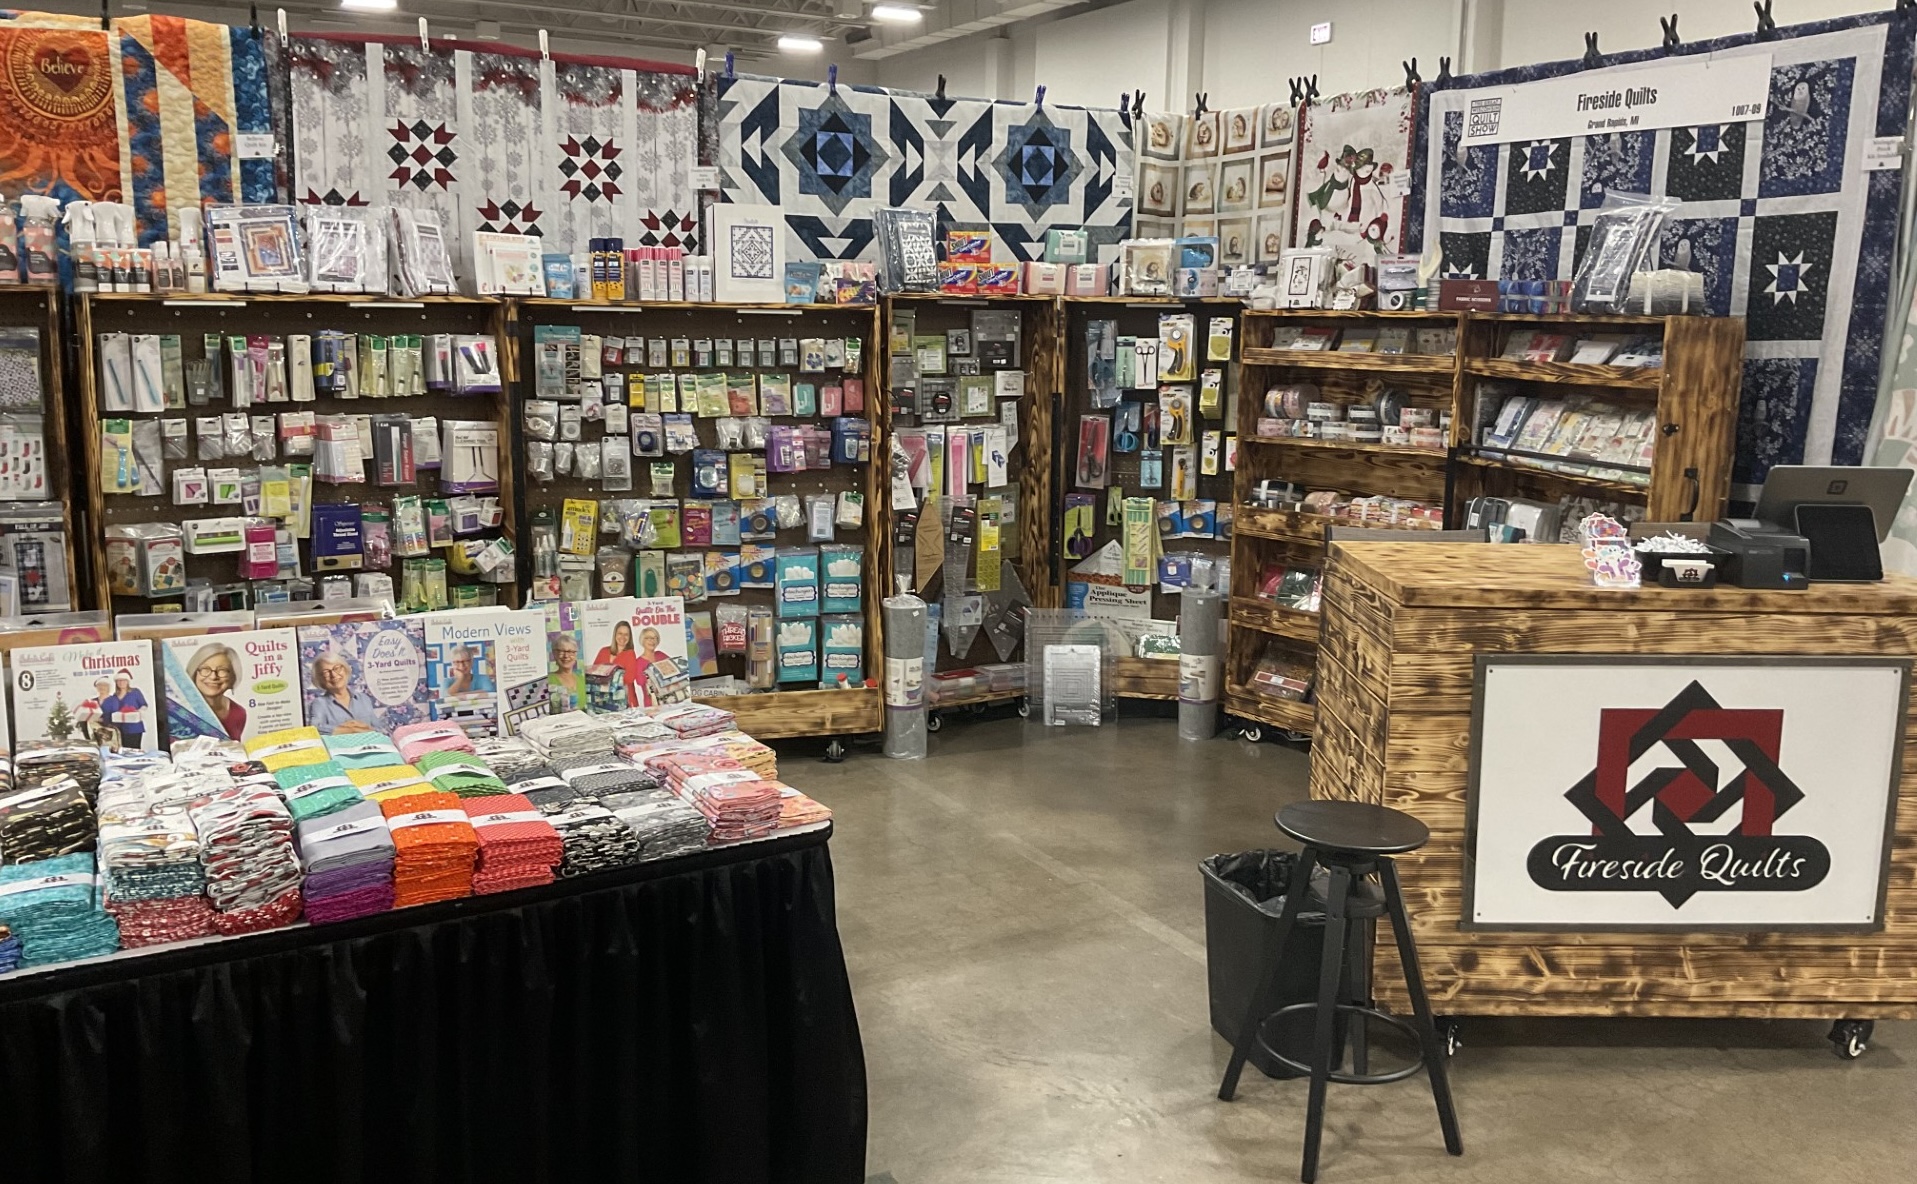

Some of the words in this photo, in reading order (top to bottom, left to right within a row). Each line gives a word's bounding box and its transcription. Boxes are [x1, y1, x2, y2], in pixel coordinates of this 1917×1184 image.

[41, 56, 84, 75] Believe
[1576, 90, 1622, 112] Fireside
[1625, 86, 1658, 110] Quilts
[1732, 103, 1761, 117] 1007-09
[1472, 112, 1498, 125] QUILT
[1587, 119, 1605, 129] Grand
[1606, 117, 1628, 129] Rapids,
[1630, 115, 1640, 125] MI
[1470, 123, 1497, 136] SHOW
[1089, 596, 1123, 605] Pressing
[1090, 589, 1127, 598] Applique
[631, 613, 681, 627] DOUBLE
[442, 625, 490, 640] Modern
[494, 622, 532, 636] Views
[245, 640, 288, 656] Quilts
[379, 635, 402, 649] Easy
[505, 644, 530, 653] 3-Yard
[264, 653, 274, 662] in
[372, 647, 395, 658] Does
[506, 653, 529, 663] Quilts
[82, 654, 140, 670] Christmas
[367, 660, 392, 669] 3-Yard
[394, 659, 416, 667] Quilts
[251, 662, 283, 679] Jiffy
[21, 672, 31, 688] 8
[249, 699, 257, 708] 8
[1551, 843, 1684, 880] Fireside
[1699, 843, 1807, 886] Quilts
